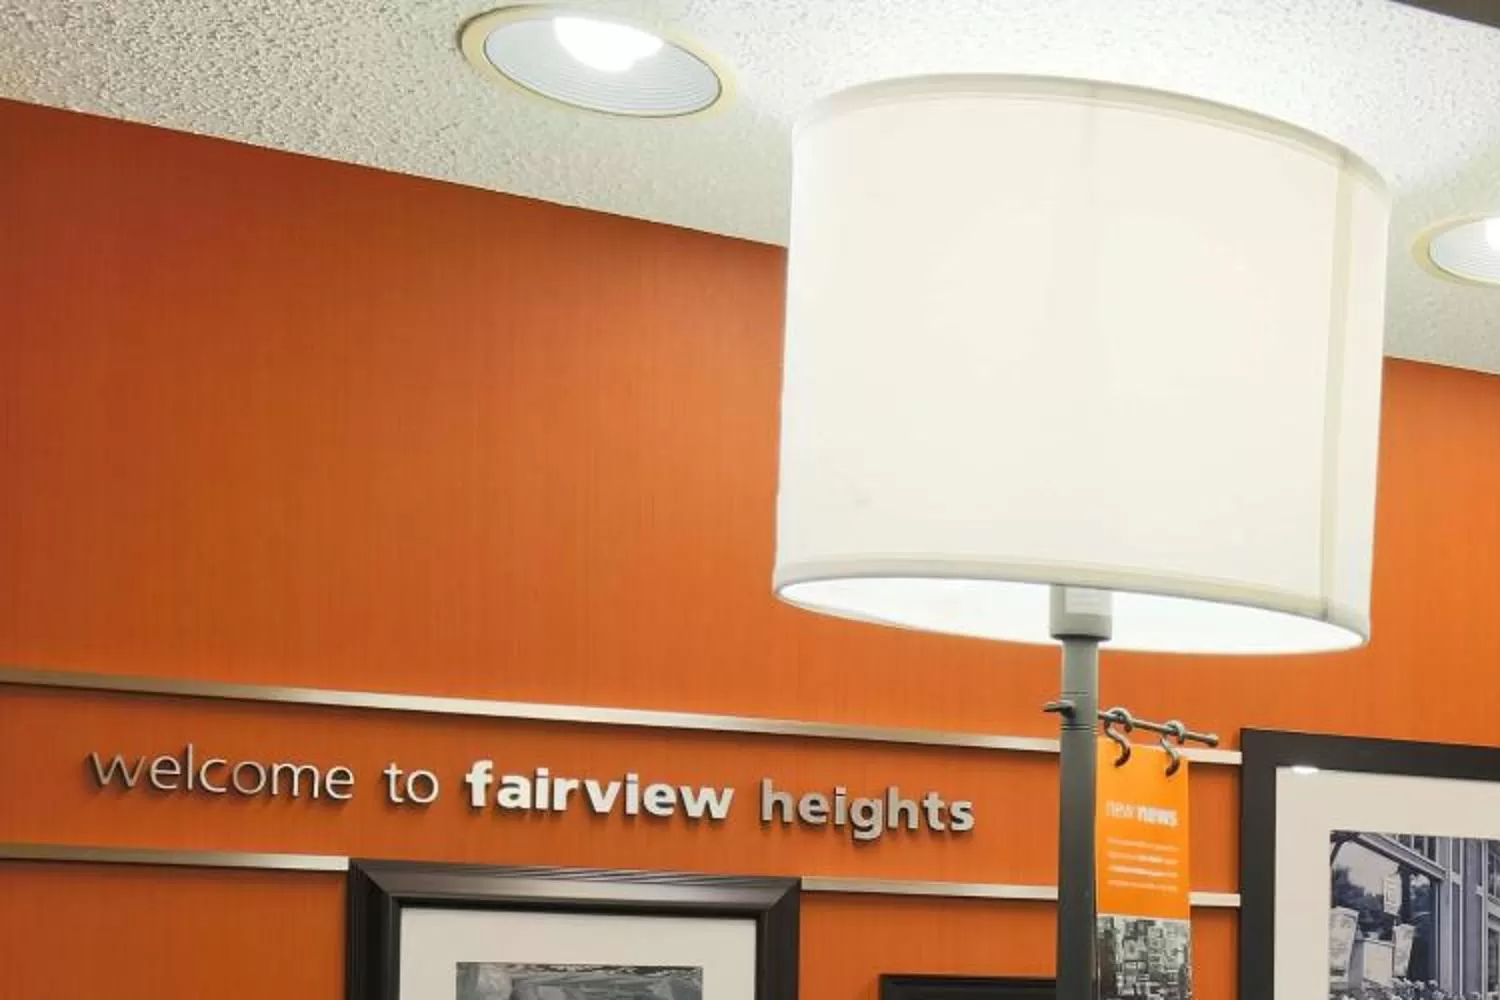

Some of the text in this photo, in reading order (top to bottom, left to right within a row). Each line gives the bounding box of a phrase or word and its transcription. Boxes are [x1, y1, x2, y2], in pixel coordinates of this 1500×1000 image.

[88, 743, 976, 842] welcome to fairview heights
